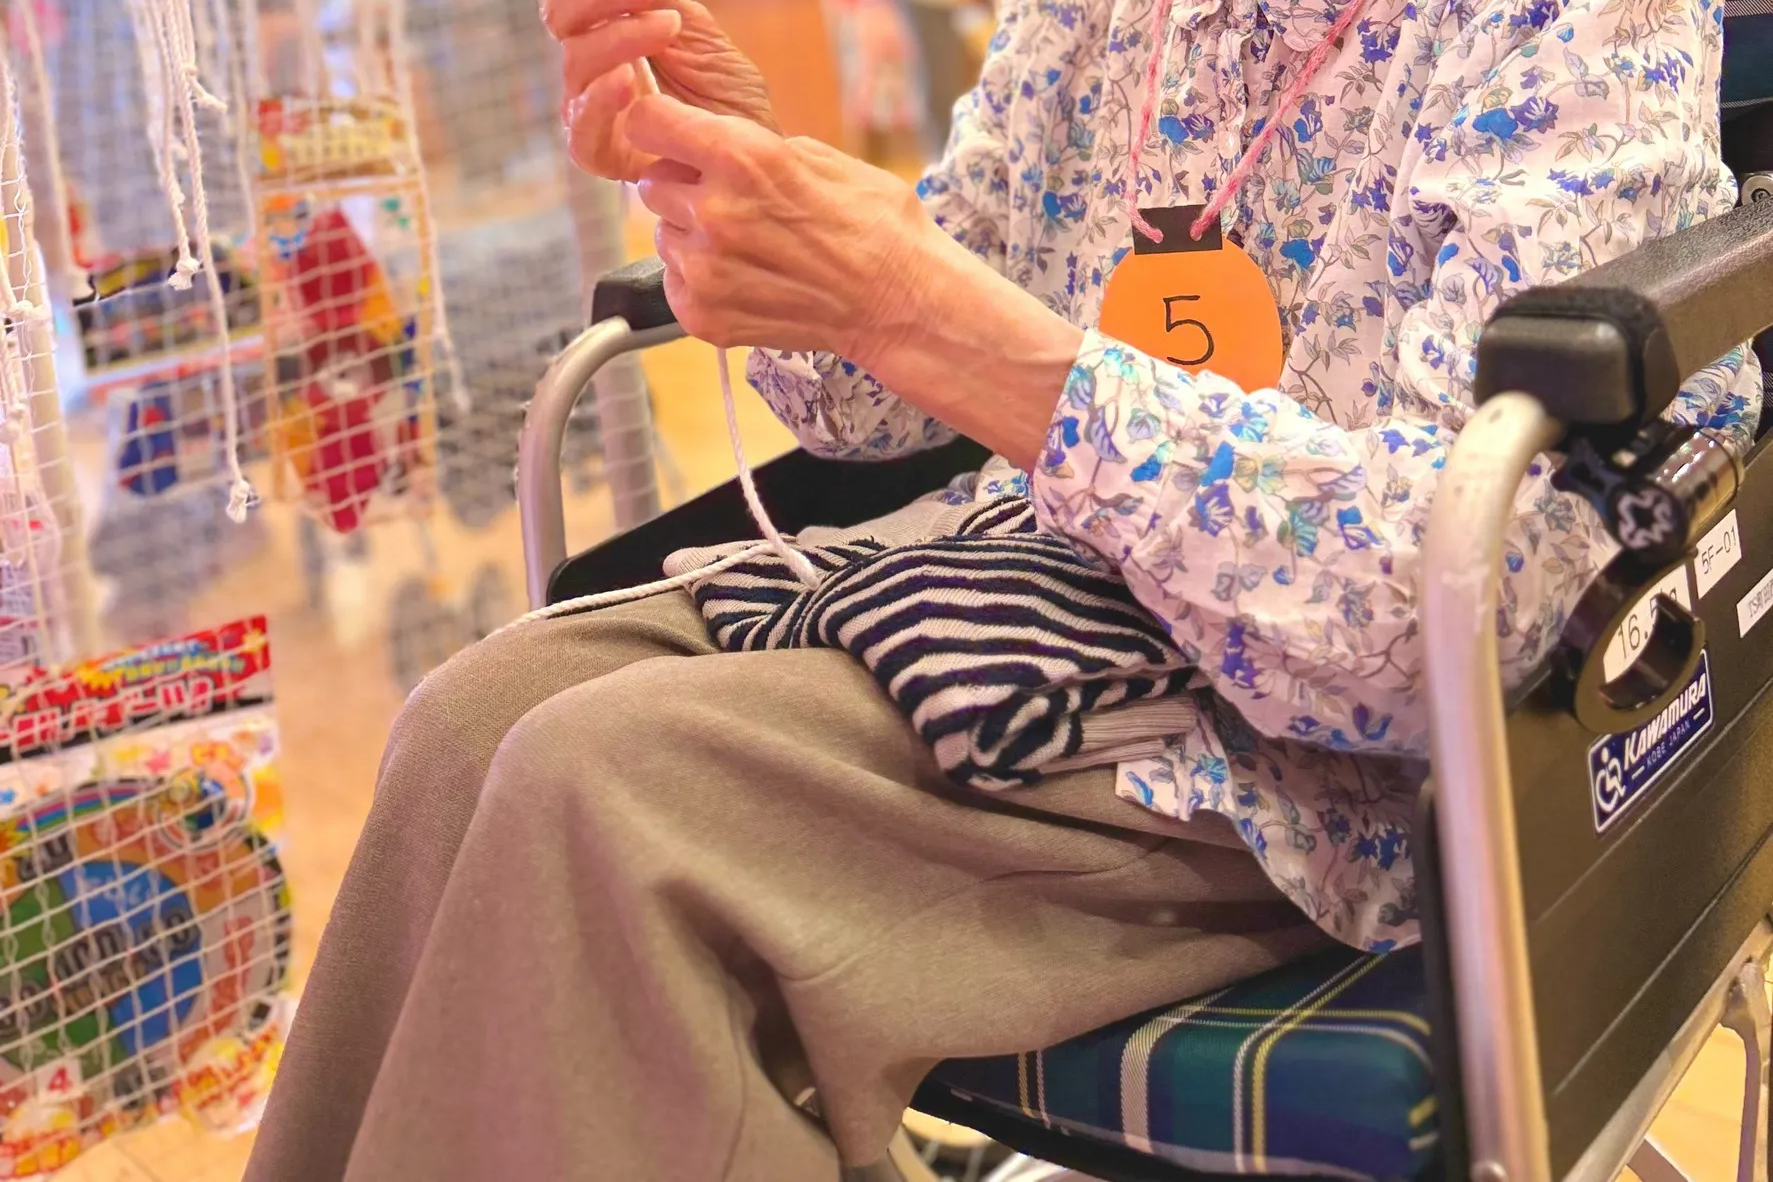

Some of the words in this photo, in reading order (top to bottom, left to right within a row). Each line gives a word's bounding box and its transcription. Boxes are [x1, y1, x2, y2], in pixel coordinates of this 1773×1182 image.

[1162, 294, 1215, 366] 5
[1701, 525, 1738, 575] 5F-01
[1624, 672, 1706, 771] KAWAMURA
[1646, 741, 1667, 767] KOBE
[1669, 719, 1691, 746] JAPAN
